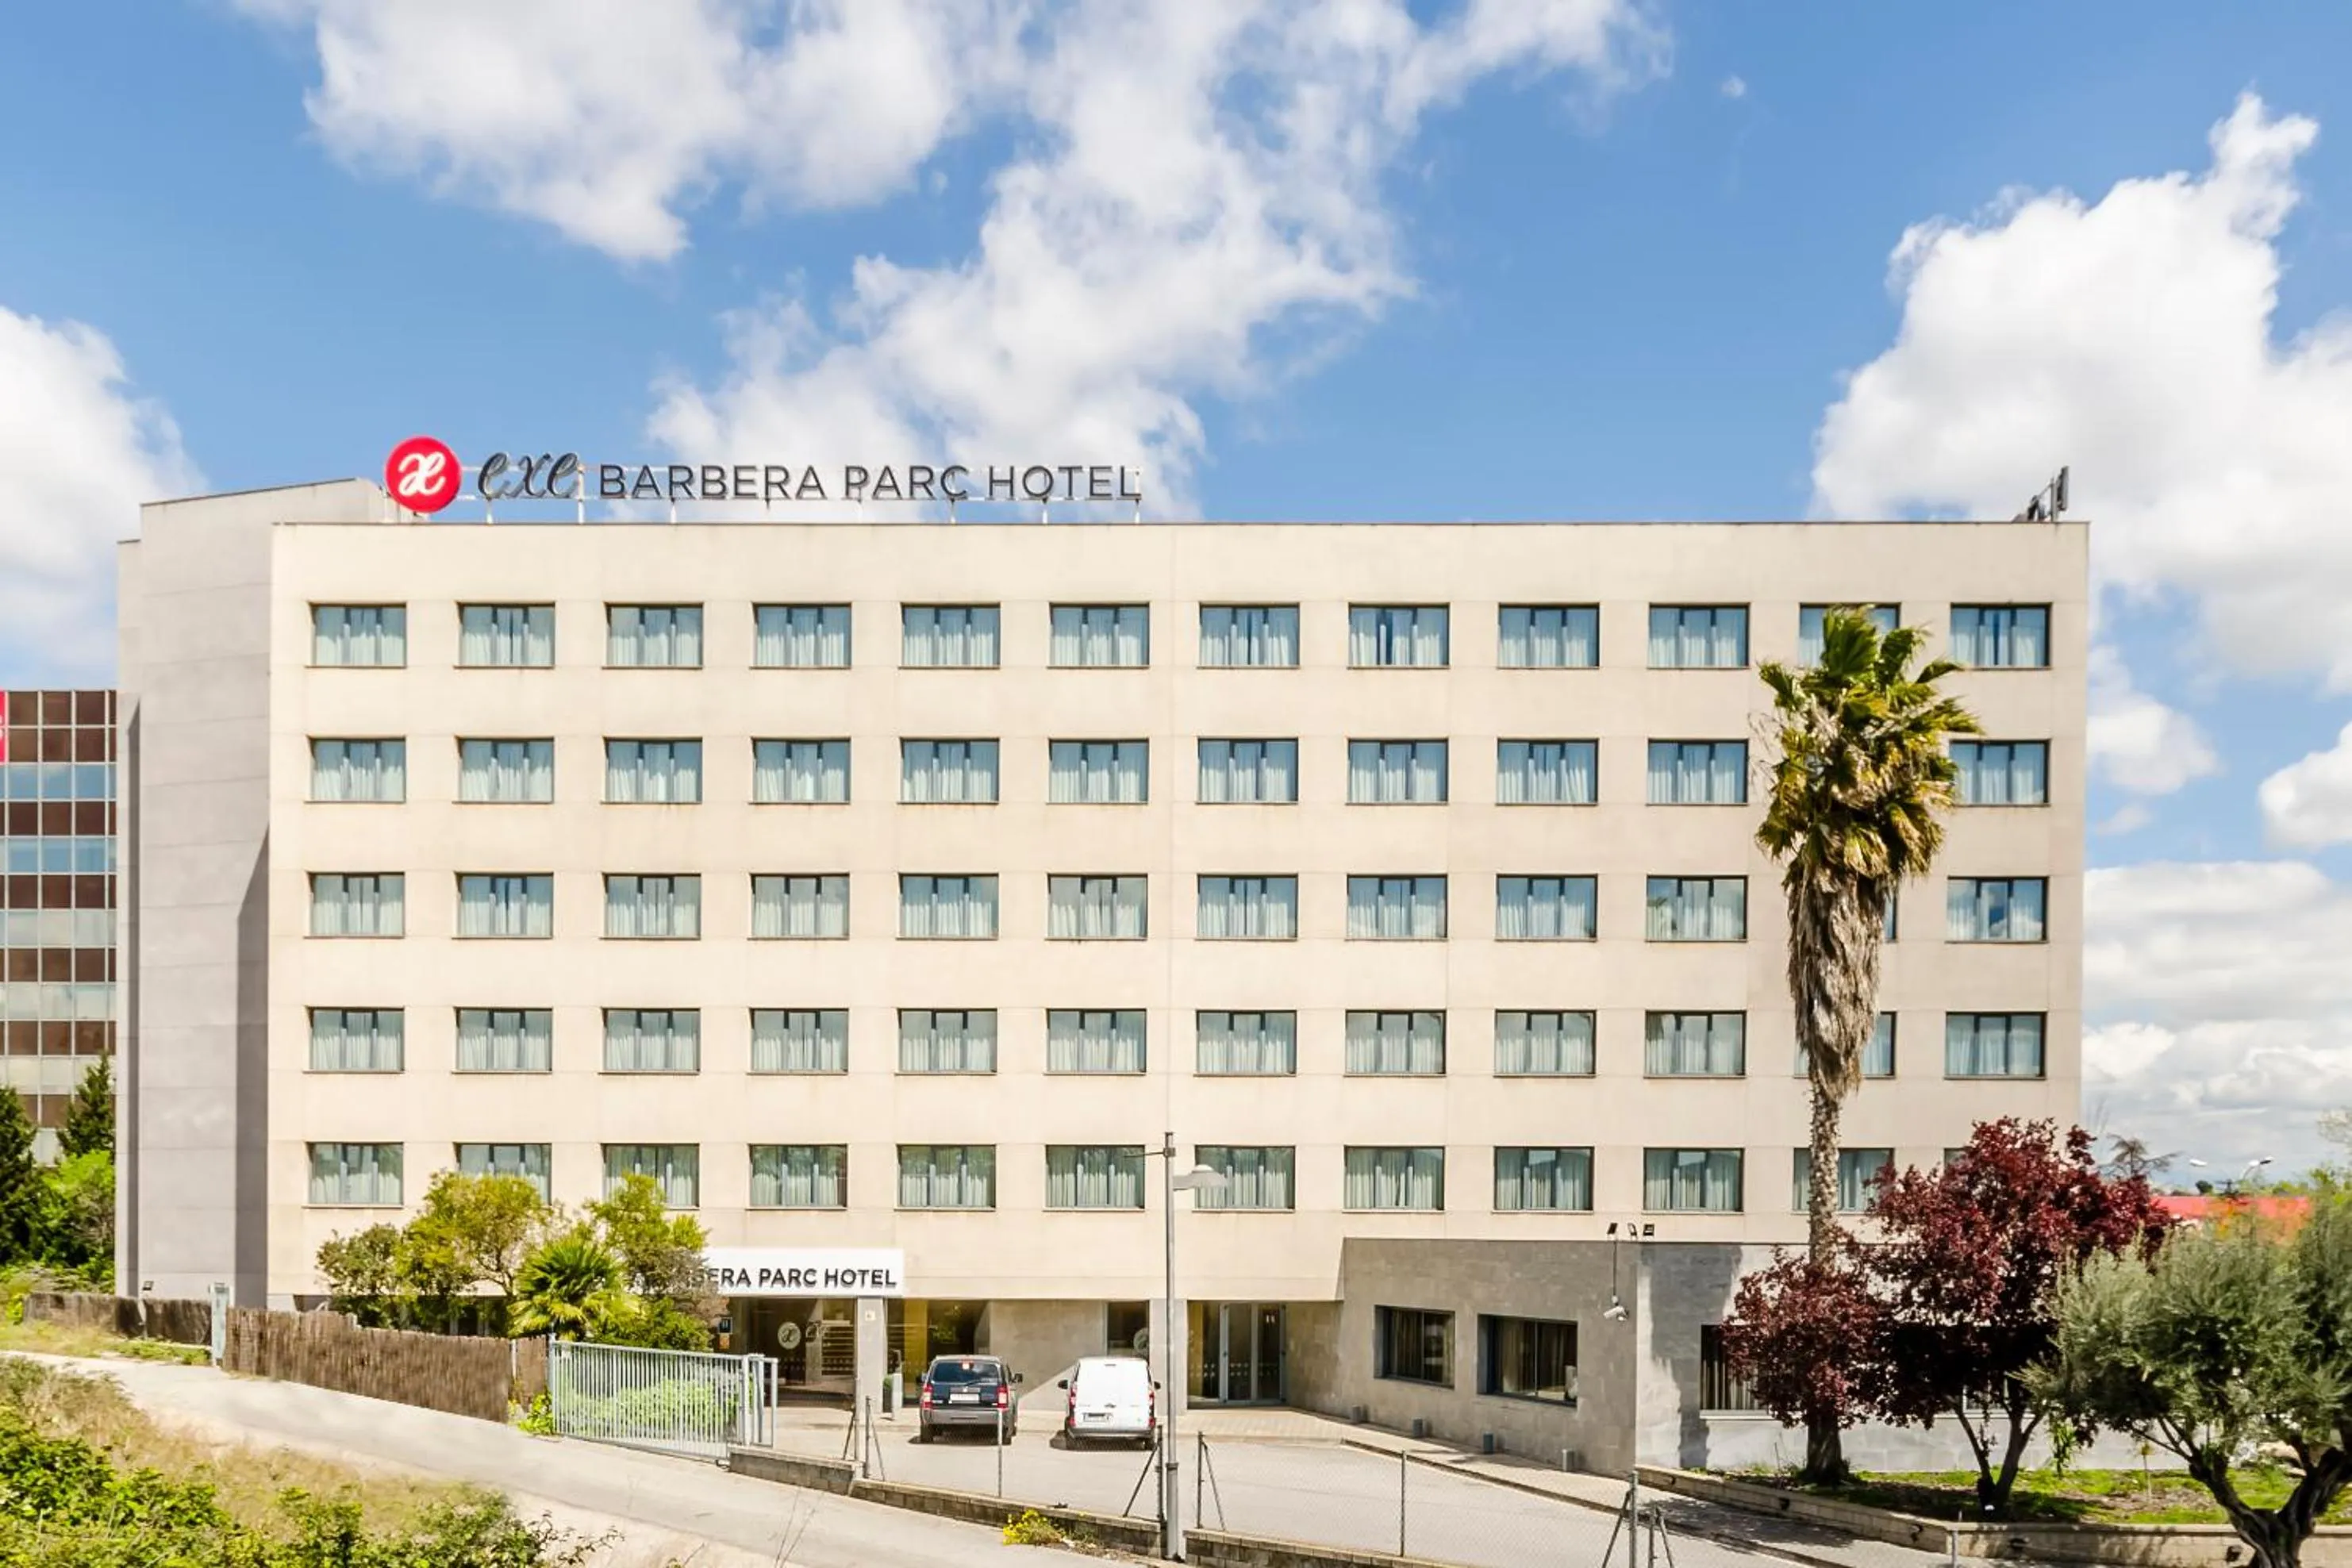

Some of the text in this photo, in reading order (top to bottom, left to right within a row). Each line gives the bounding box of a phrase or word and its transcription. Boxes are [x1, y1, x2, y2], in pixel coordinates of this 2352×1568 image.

[478, 452, 1142, 499] exe BARBERA PARC HOTEL
[759, 1267, 817, 1287] PARC
[824, 1268, 897, 1287] HOTEL
